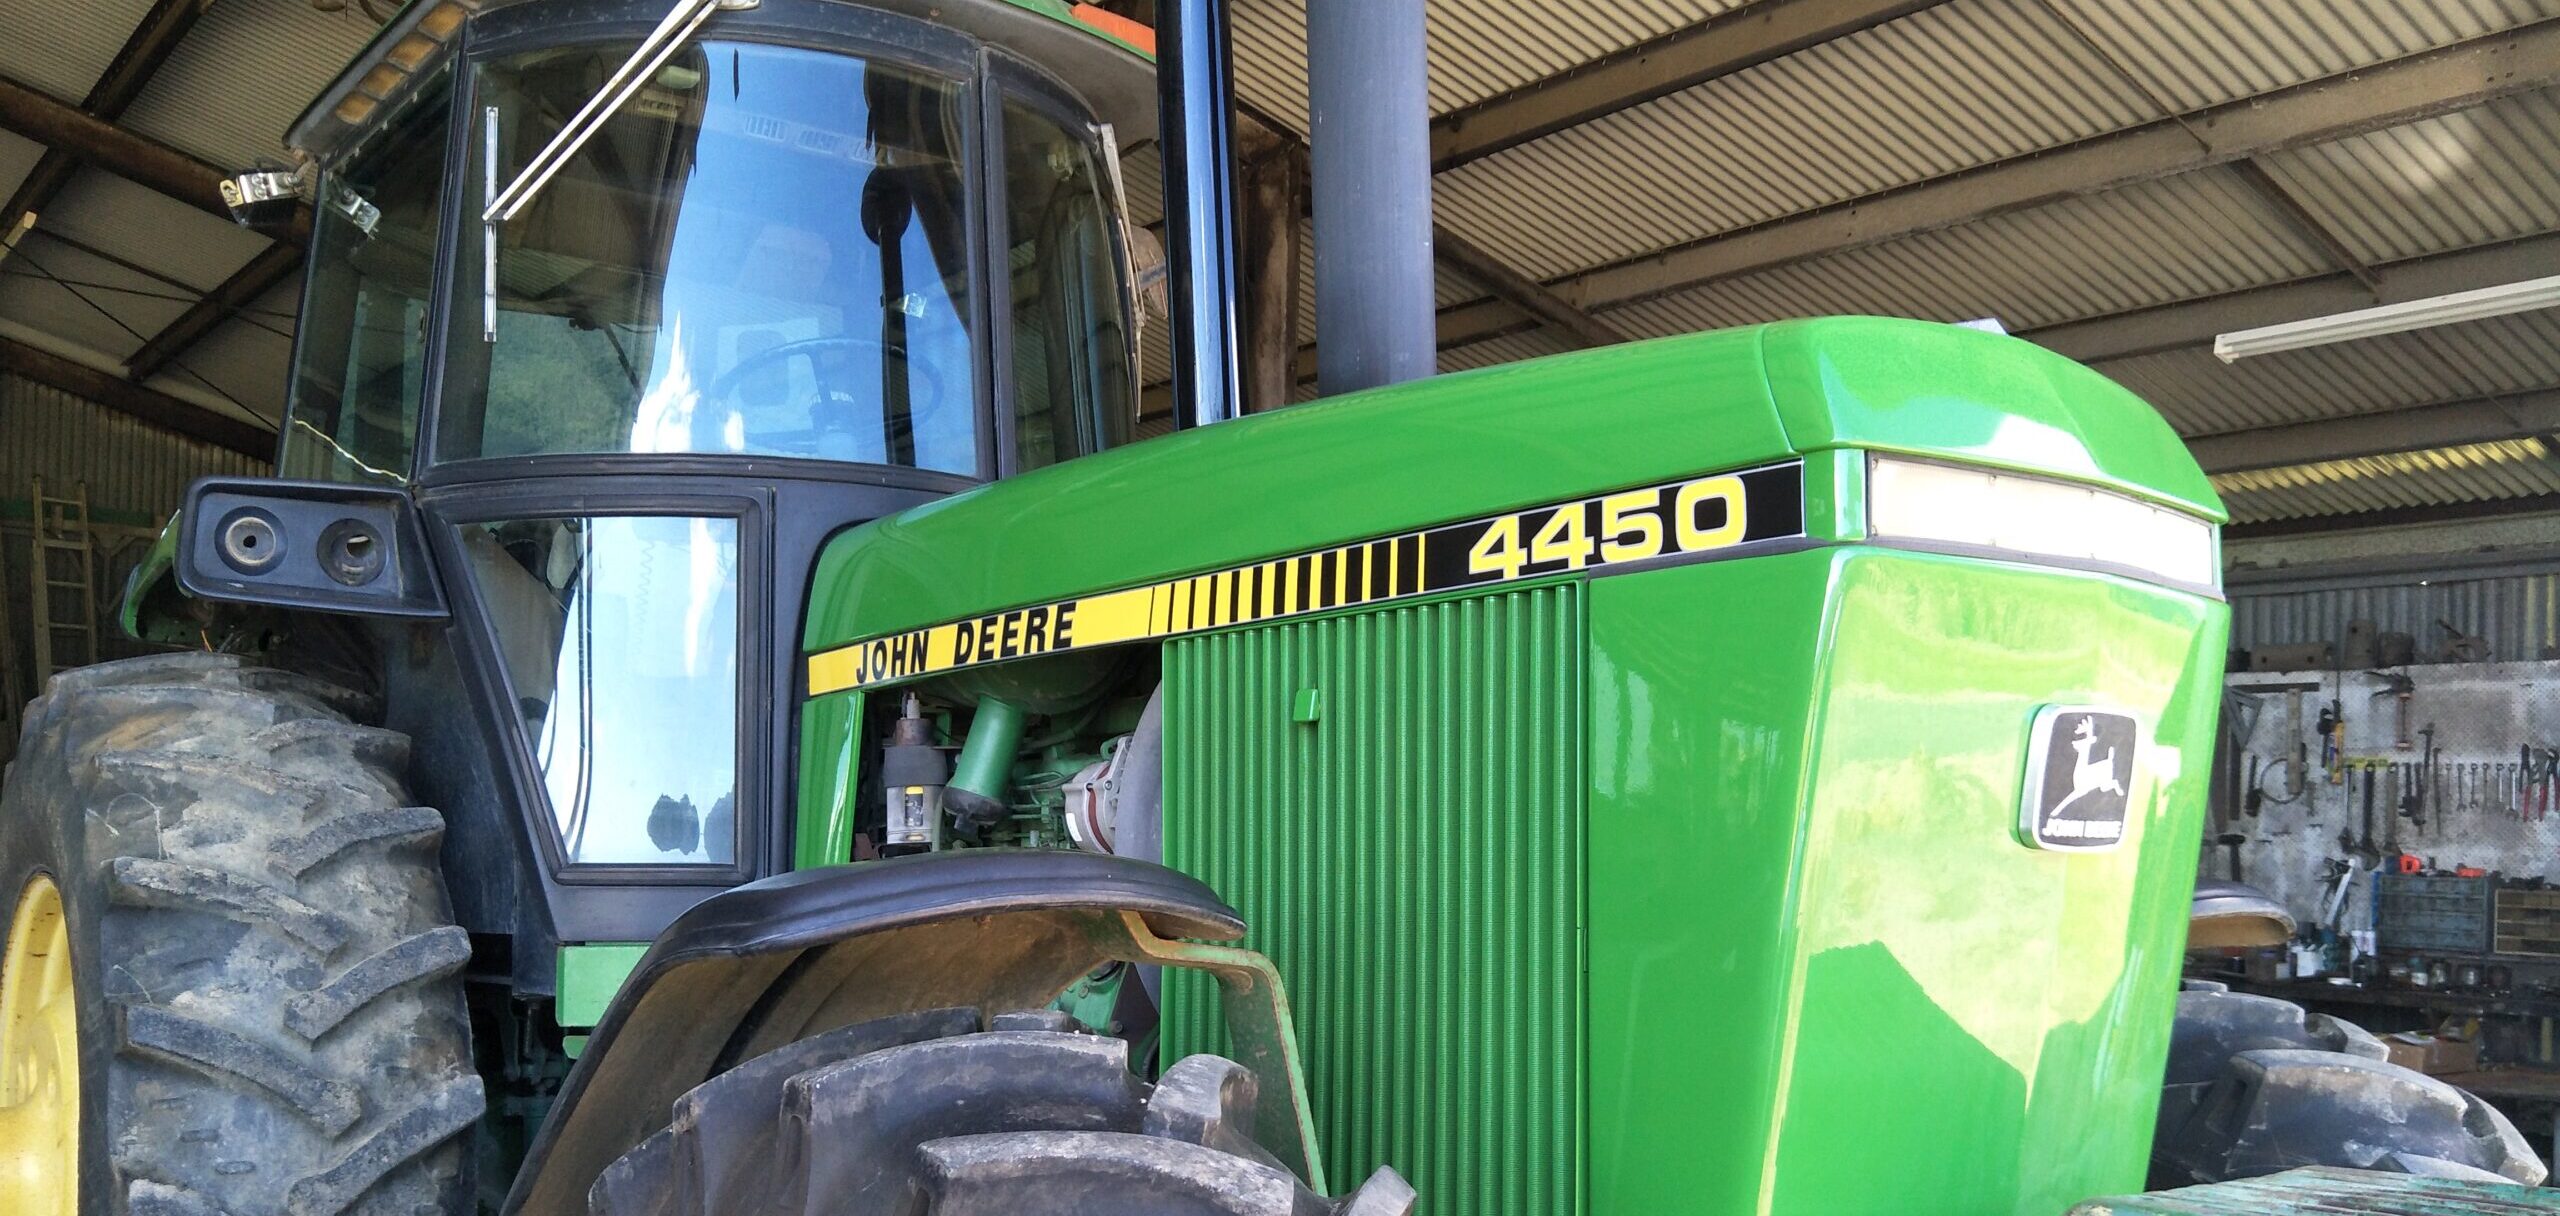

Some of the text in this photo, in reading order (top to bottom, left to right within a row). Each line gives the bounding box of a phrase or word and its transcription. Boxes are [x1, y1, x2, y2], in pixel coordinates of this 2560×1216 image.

[1468, 474, 1747, 580] 4450
[856, 601, 1077, 684] JOHN DEERE
[2042, 818, 2084, 837] JO
